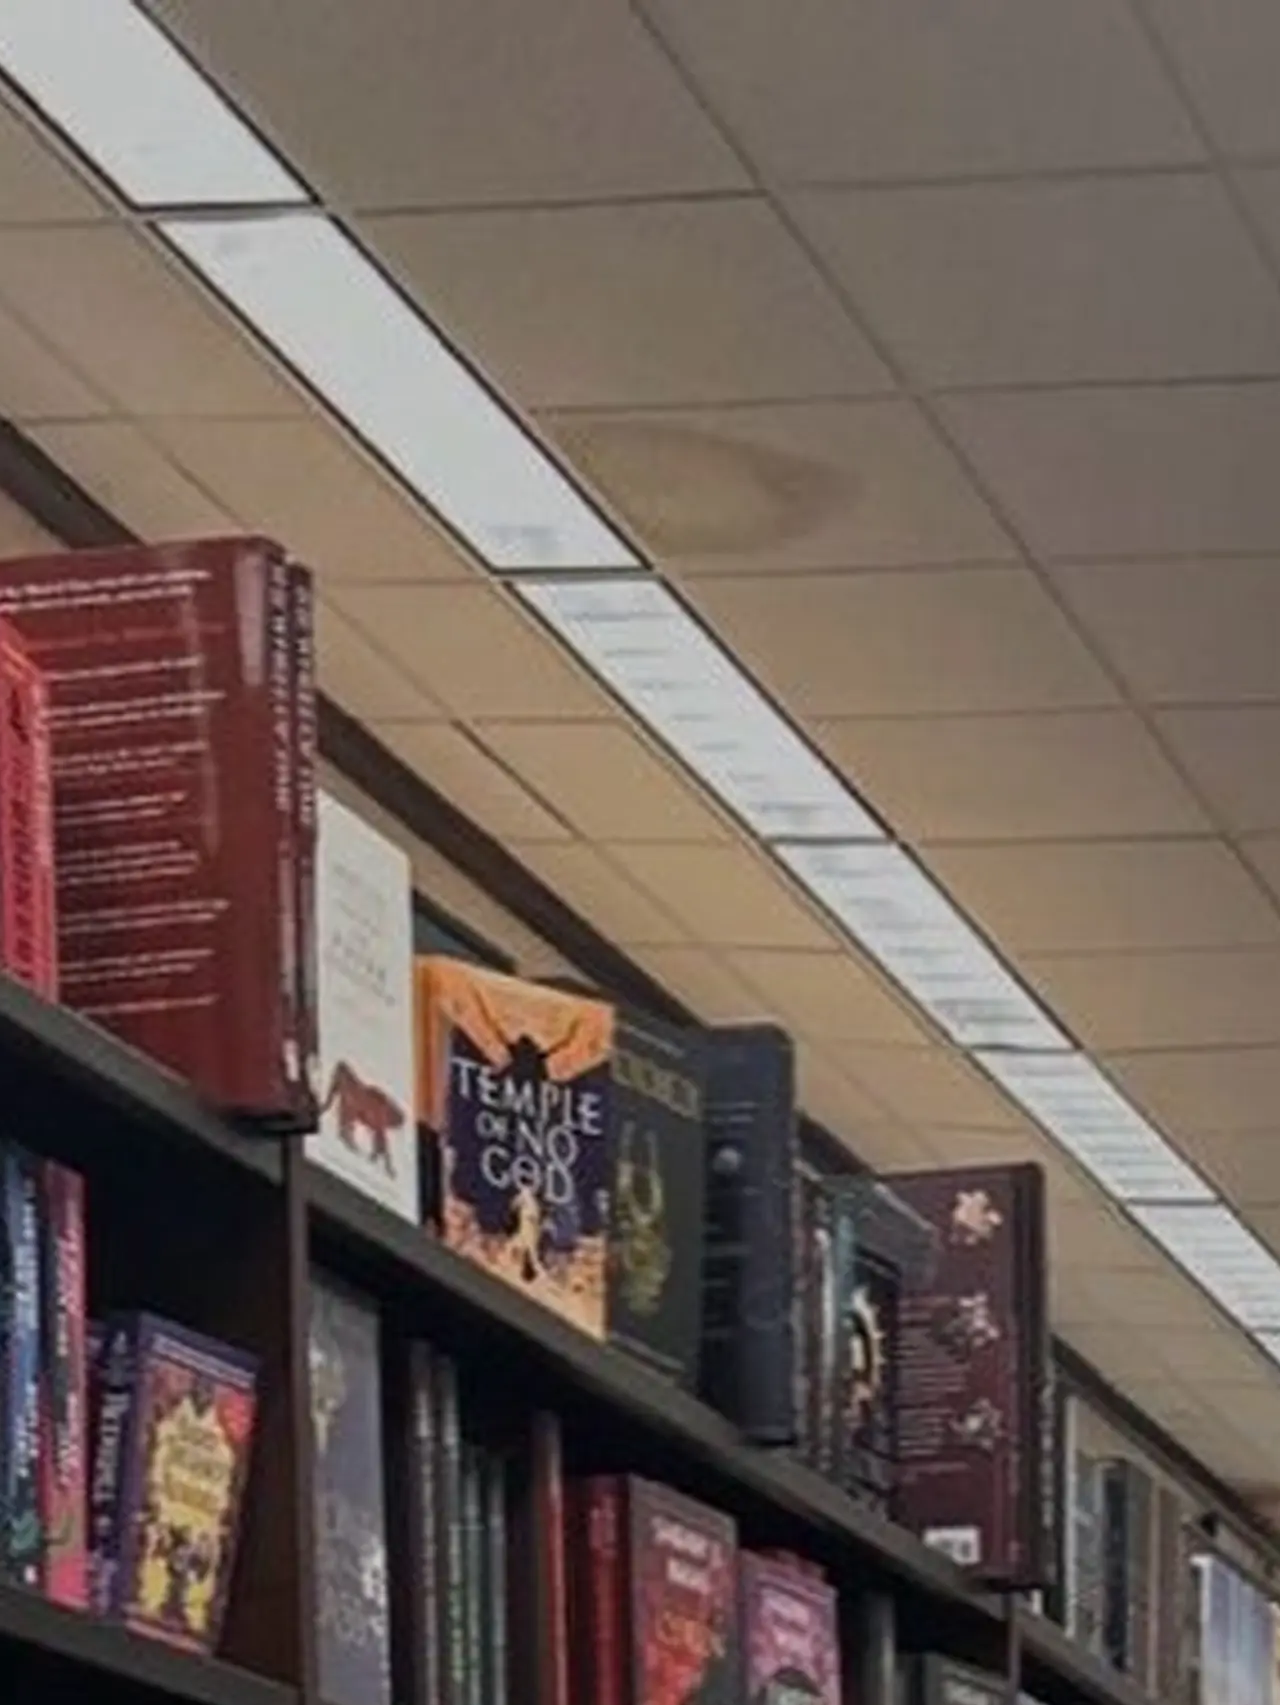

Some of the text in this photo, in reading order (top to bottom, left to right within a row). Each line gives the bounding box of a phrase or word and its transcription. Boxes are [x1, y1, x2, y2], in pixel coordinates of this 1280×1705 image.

[450, 1054, 604, 1137] TEMPLE
[479, 1143, 576, 1206] GOD
[517, 1118, 579, 1168] NO
